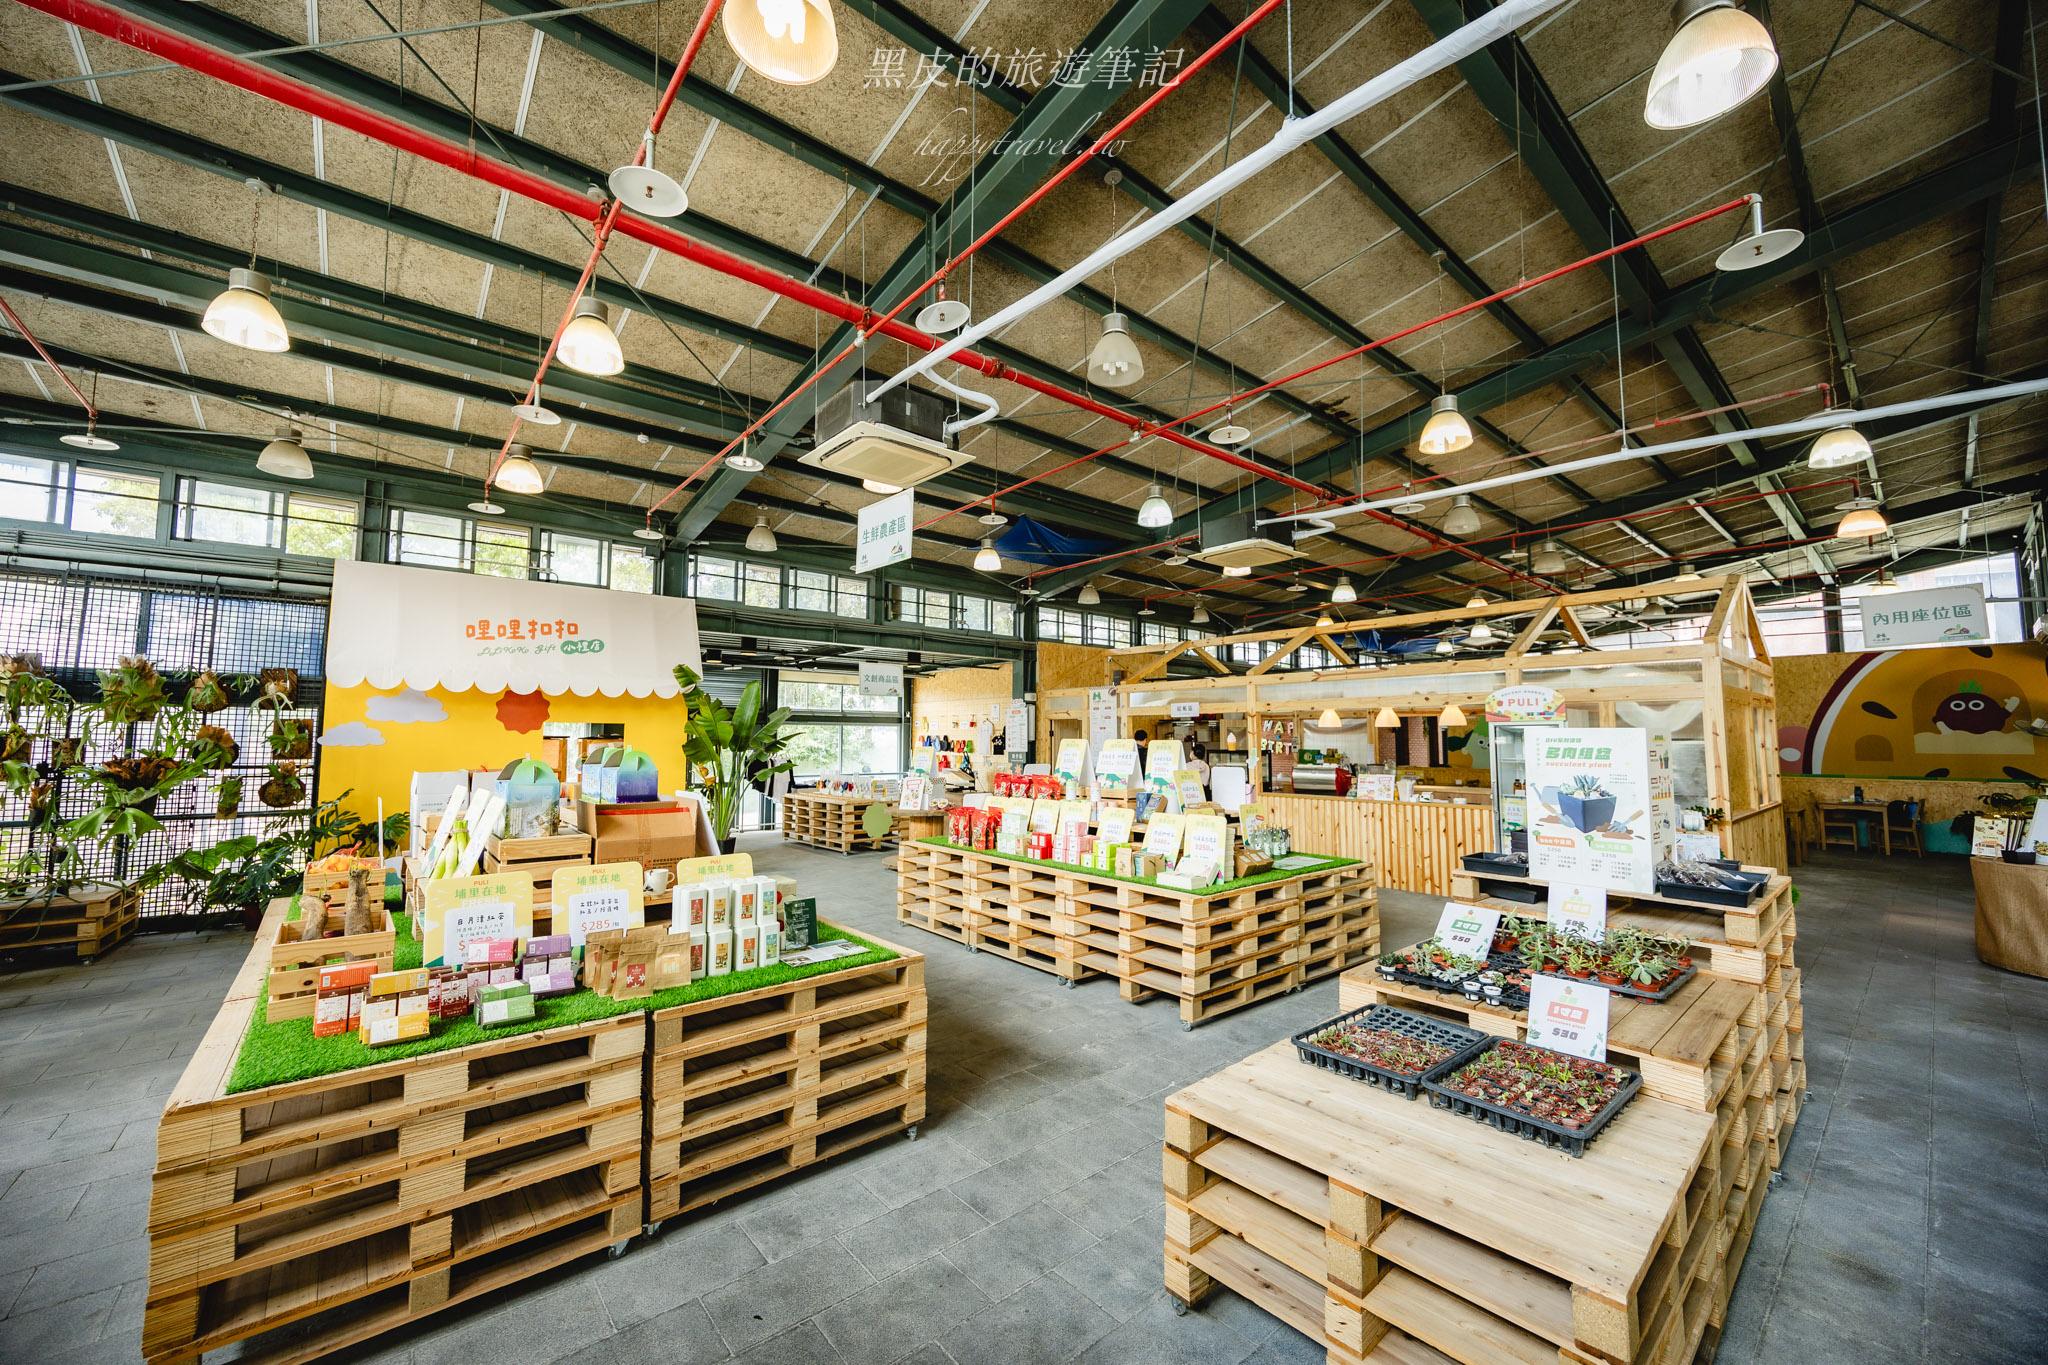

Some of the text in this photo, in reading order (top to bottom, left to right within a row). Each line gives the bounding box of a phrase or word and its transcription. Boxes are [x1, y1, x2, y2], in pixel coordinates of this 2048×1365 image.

[862, 515, 906, 544] 生鮮農產區
[1872, 603, 1973, 626] 內用座位區
[466, 618, 579, 640] 哩哩扣扣
[864, 674, 898, 682] 文創商品區
[1508, 698, 1539, 706] PULI
[576, 873, 620, 885] 埔里在地
[455, 884, 507, 898] 埔里在地
[581, 920, 610, 931] $285
[1451, 935, 1471, 943] $50
[1552, 1027, 1579, 1040] $30
